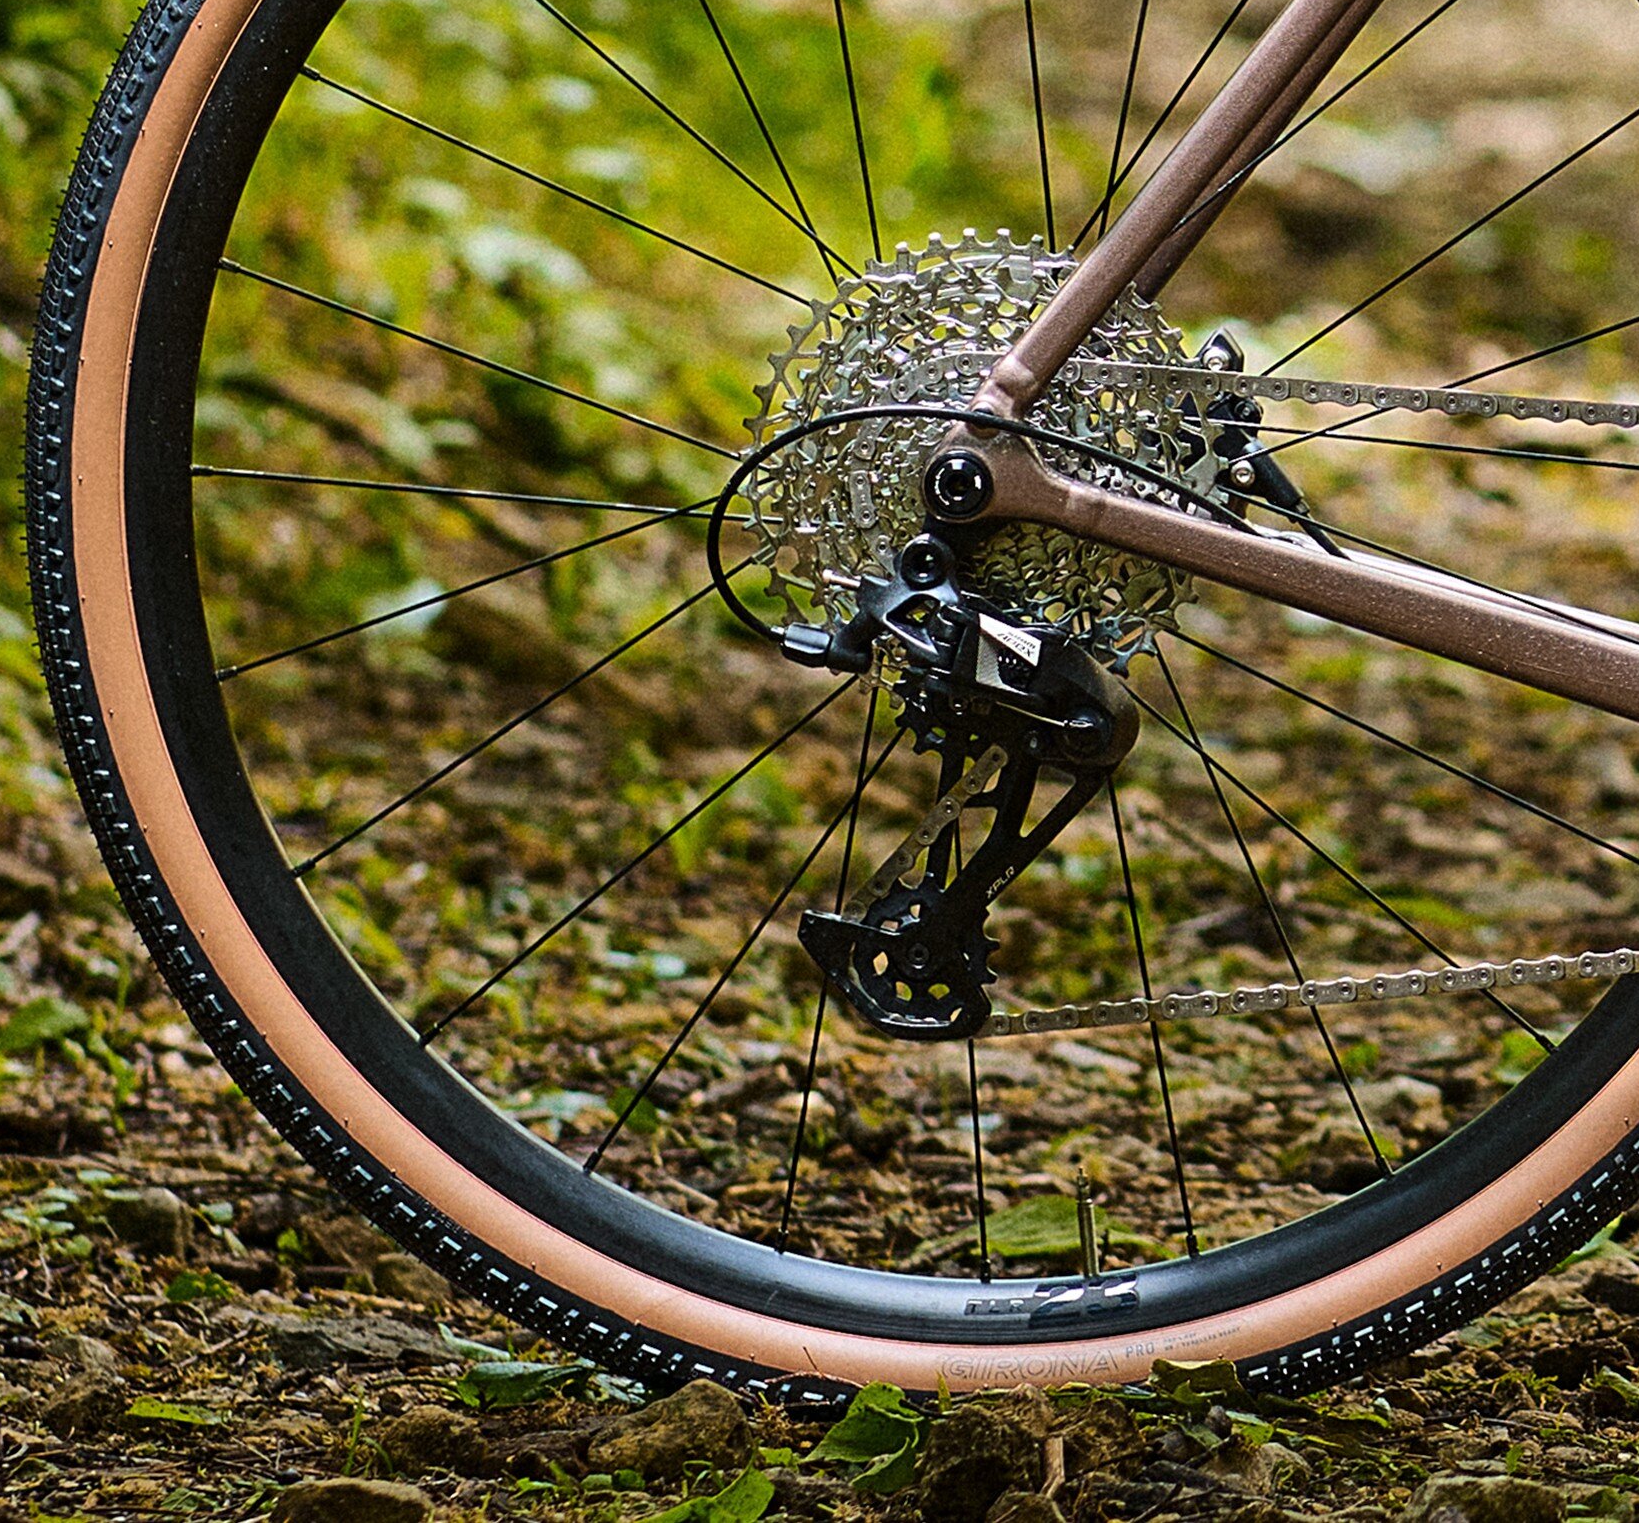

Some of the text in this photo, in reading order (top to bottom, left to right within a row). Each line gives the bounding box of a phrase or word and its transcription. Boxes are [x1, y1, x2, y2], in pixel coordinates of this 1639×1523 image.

[985, 866, 1015, 899] XPLR
[940, 1341, 1156, 1381] GIRONA PRO
